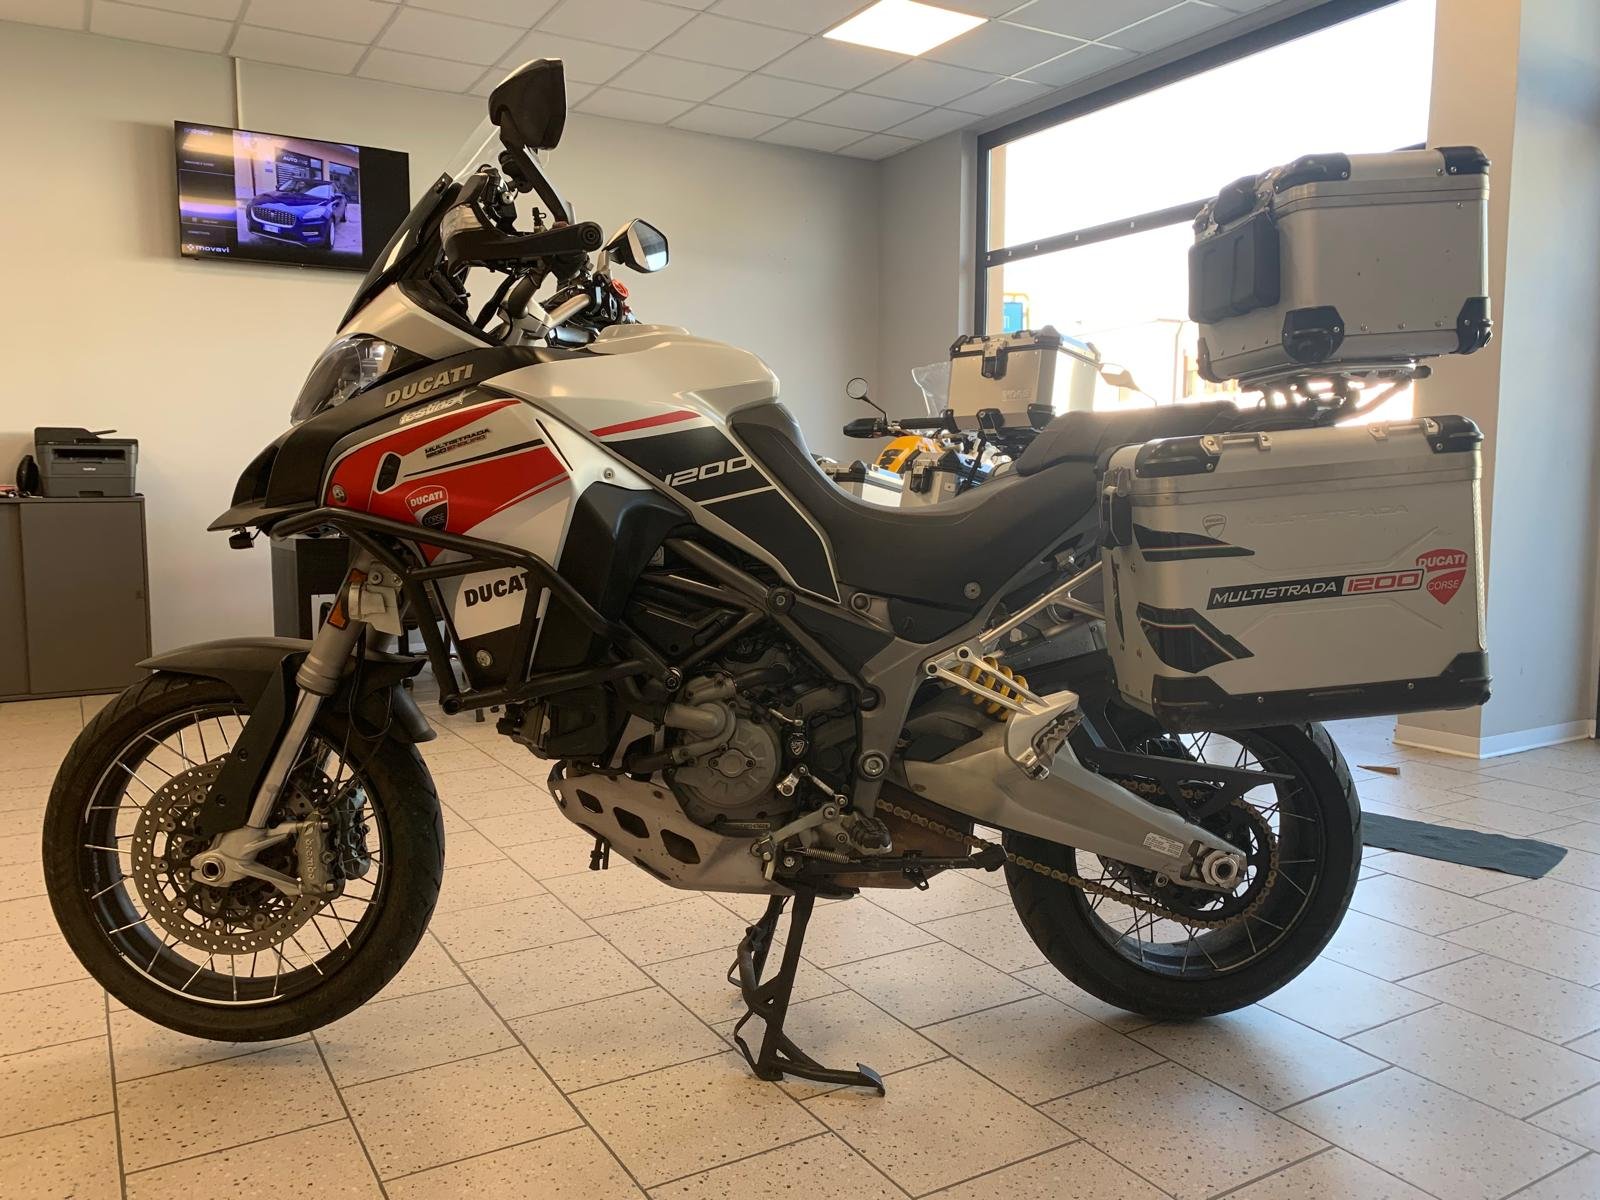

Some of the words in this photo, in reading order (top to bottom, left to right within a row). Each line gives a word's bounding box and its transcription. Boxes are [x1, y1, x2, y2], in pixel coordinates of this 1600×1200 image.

[195, 245, 230, 253] movavi
[384, 364, 474, 408] DUCATI
[424, 428, 490, 454] MULTISTRADA
[664, 456, 752, 487] 1200
[410, 490, 444, 507] DUCATI
[1419, 553, 1466, 568] DUCATI
[464, 572, 529, 608] DUCAT
[1213, 581, 1337, 605] MULTISTRADA
[1347, 572, 1420, 593] 1200
[1426, 578, 1460, 592] CORSE
[304, 838, 317, 880] brembo
